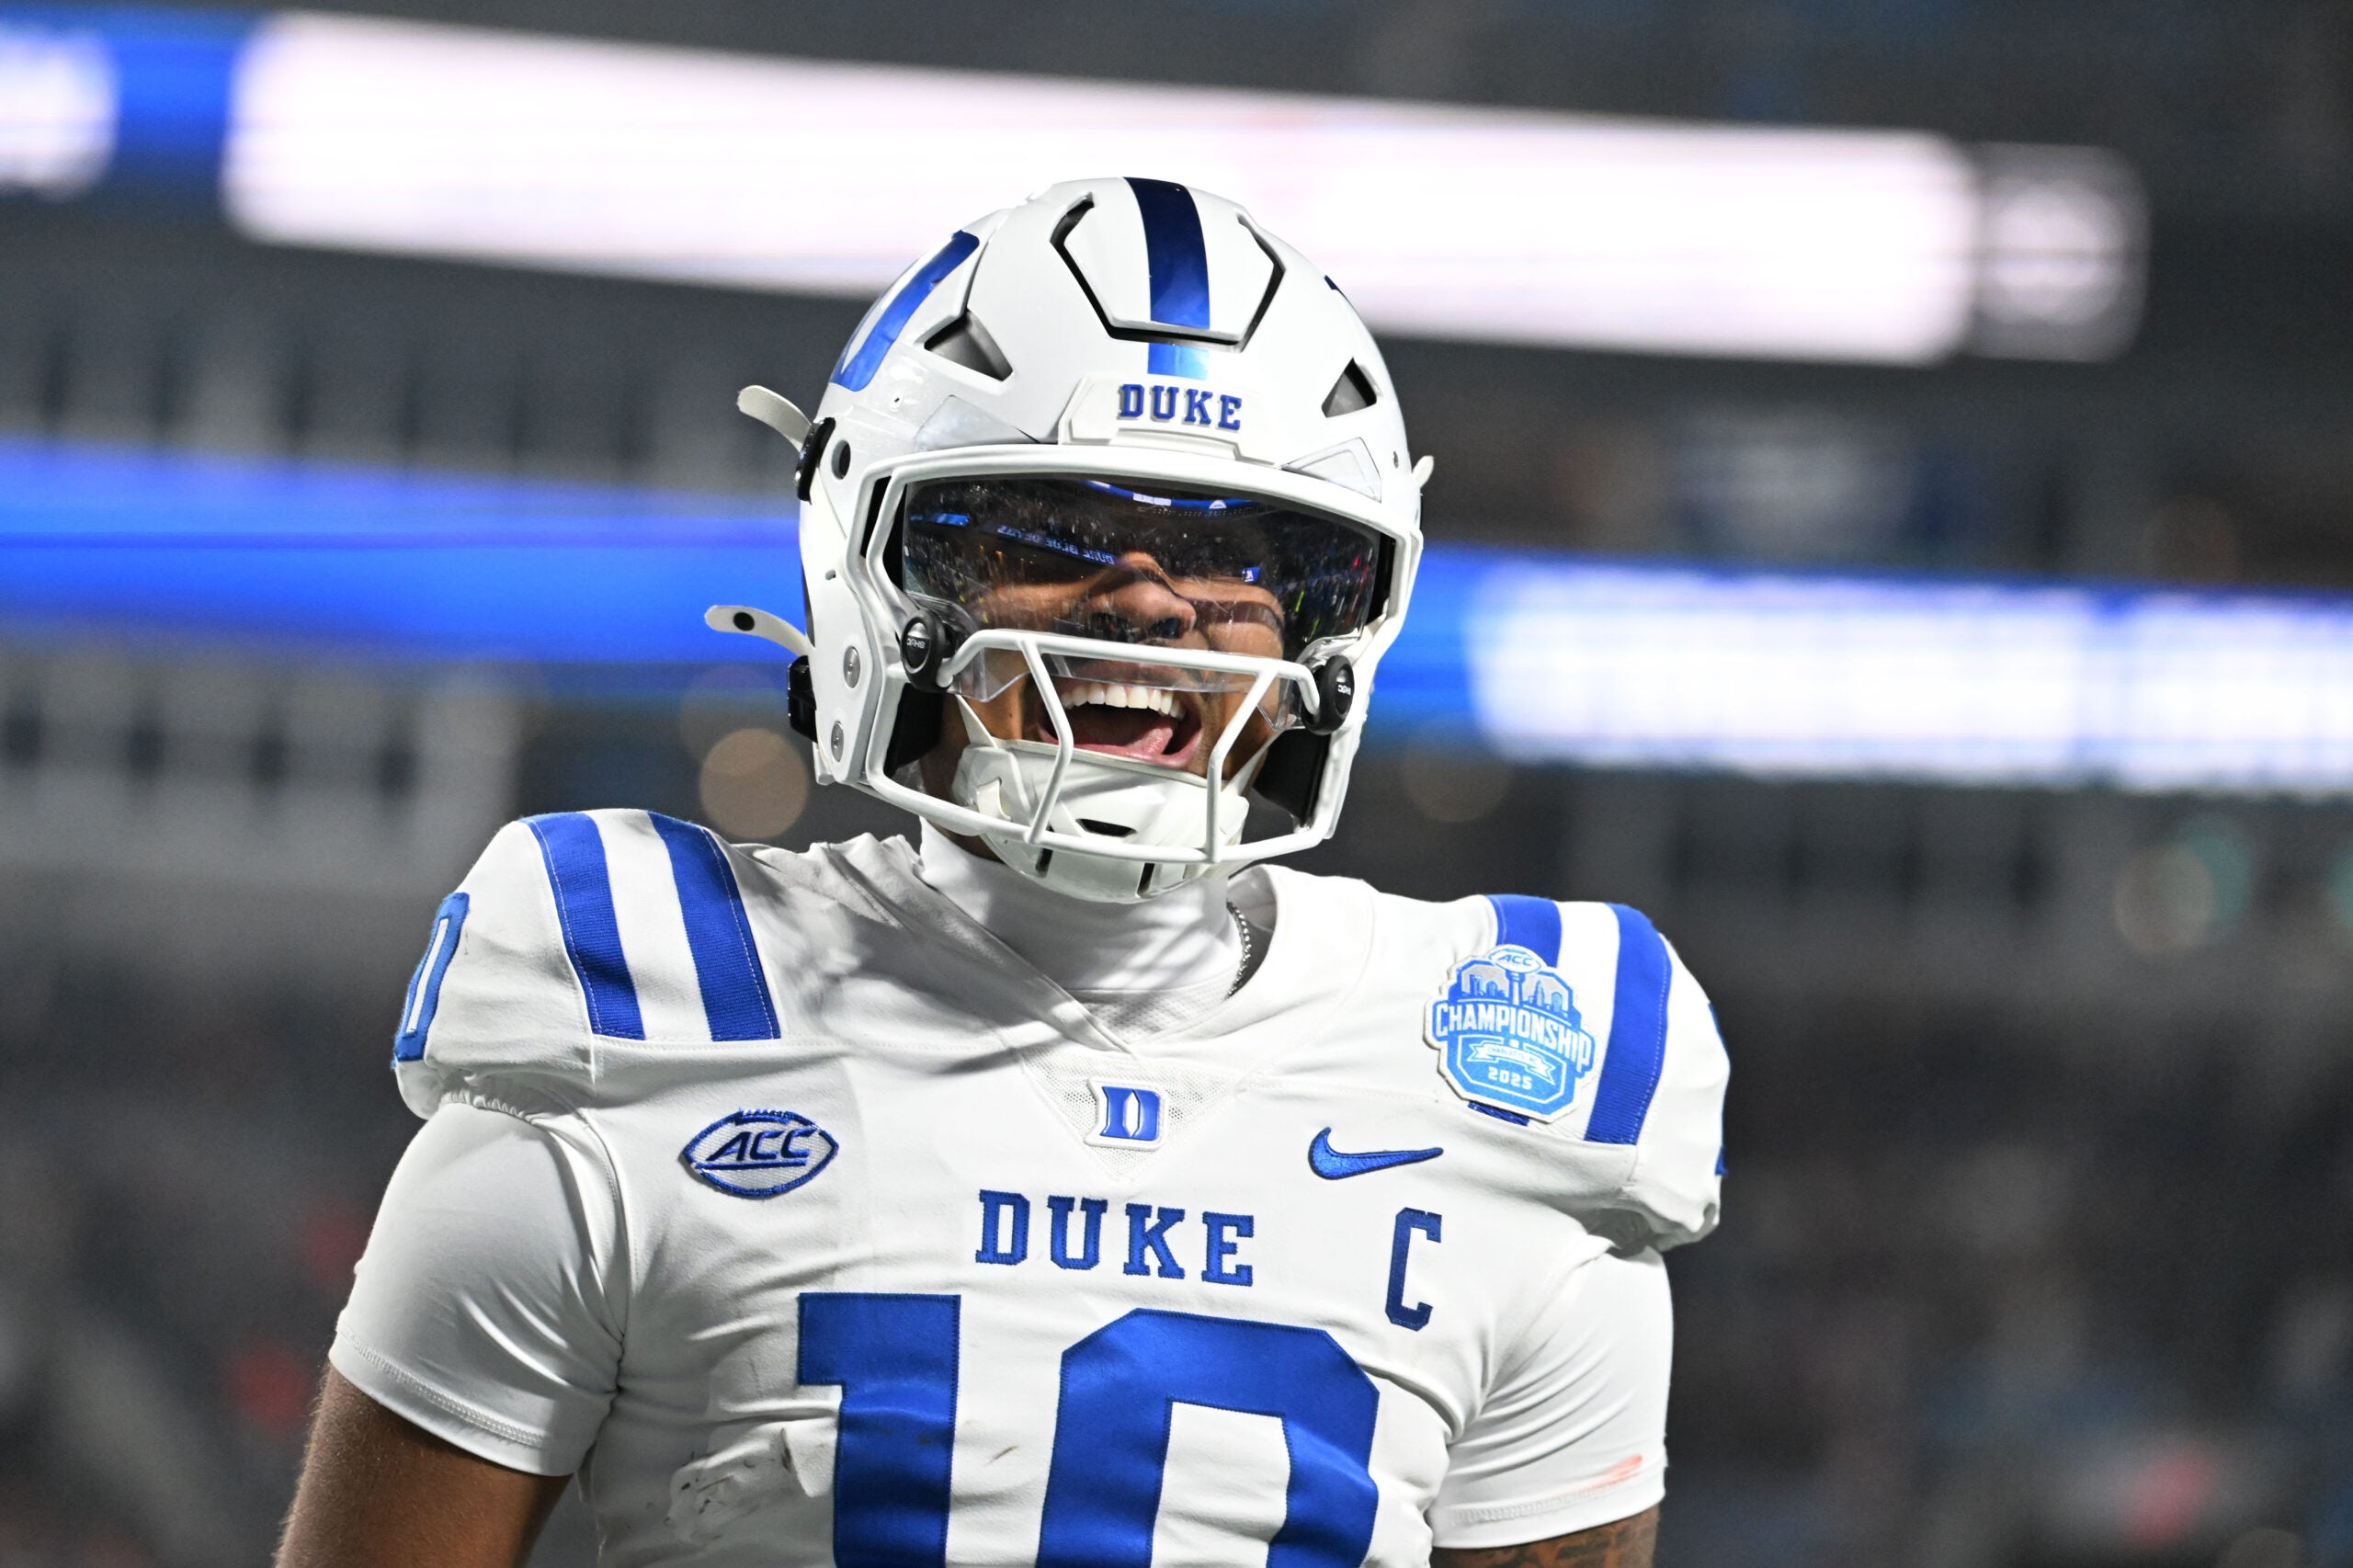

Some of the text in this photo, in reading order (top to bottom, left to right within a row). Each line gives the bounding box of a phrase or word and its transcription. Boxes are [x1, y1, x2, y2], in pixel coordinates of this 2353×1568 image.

[1118, 383, 1243, 432] DUKE
[1498, 954, 1534, 967] ACC
[1435, 1002, 1593, 1074] CHAMPIONSHIP
[1487, 1065, 1533, 1091] 2025
[1099, 1085, 1162, 1142] D
[705, 1128, 817, 1162] ACC
[975, 1189, 1255, 1287] DUKE
[1385, 1207, 1442, 1332] C
[798, 1291, 1381, 1568] 10
